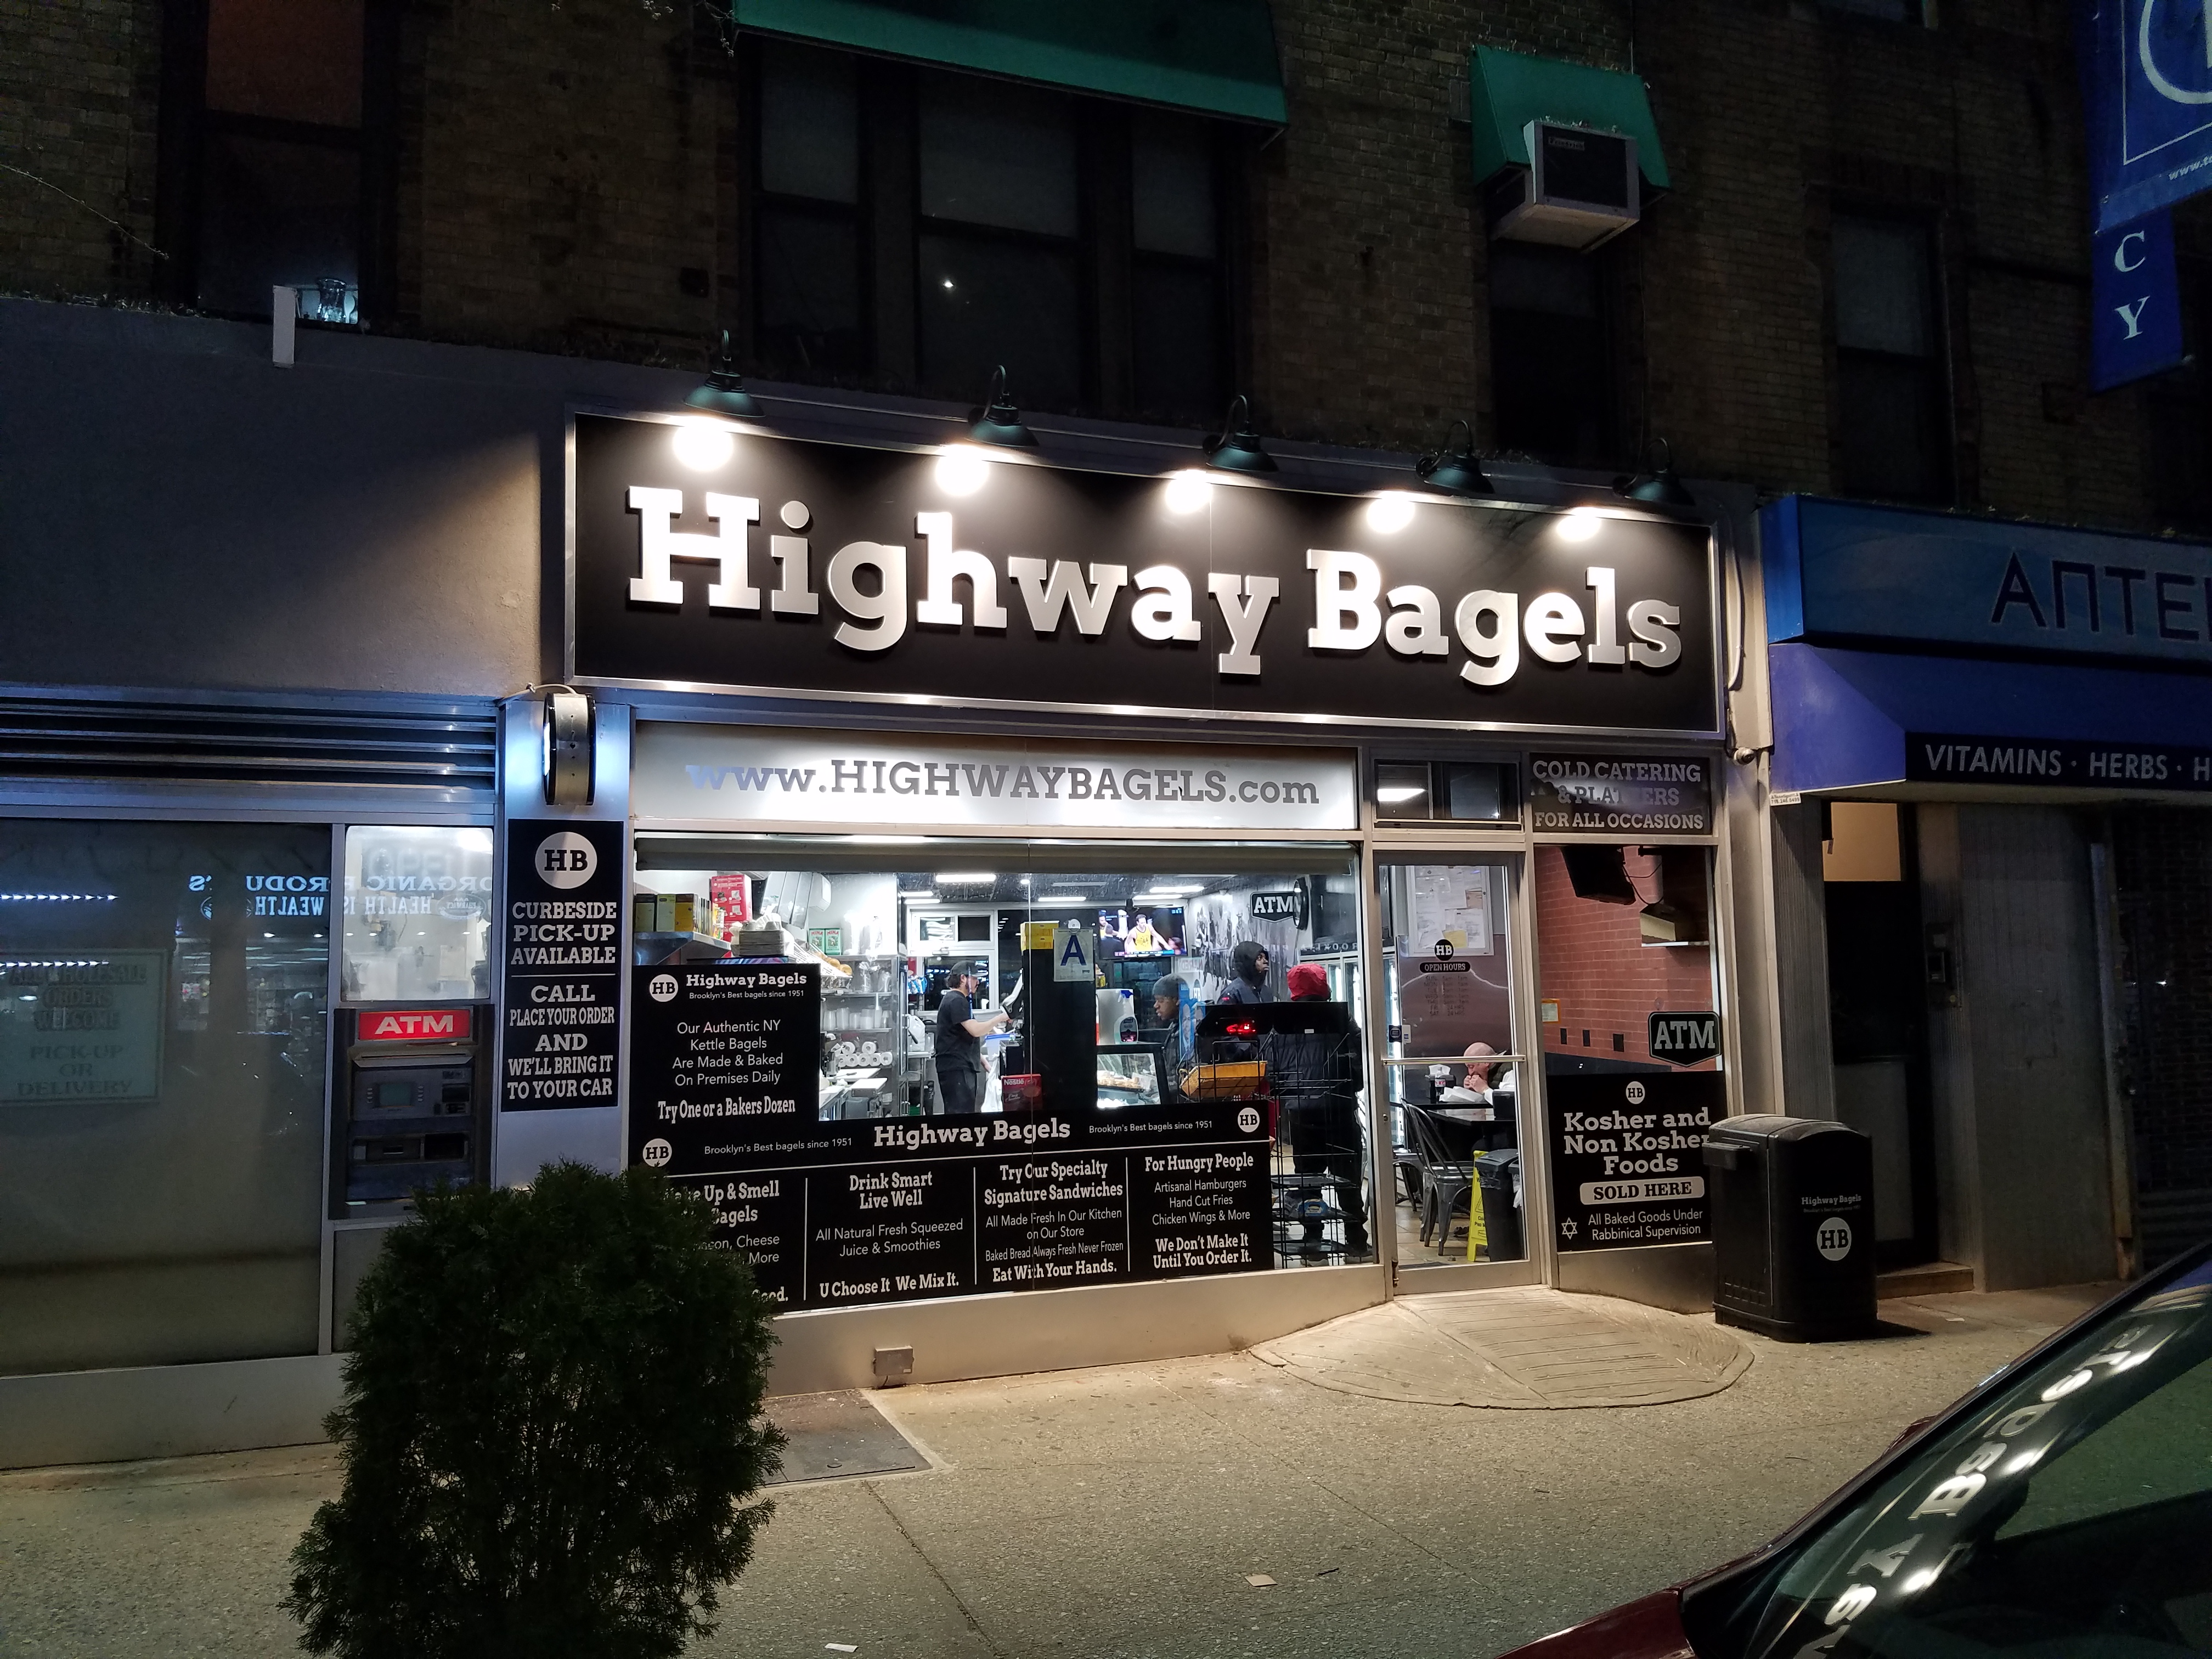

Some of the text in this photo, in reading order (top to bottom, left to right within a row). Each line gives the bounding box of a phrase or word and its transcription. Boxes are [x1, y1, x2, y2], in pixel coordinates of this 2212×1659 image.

[629, 484, 1679, 685] Highway Bagels
[1991, 551, 2212, 642] АПТЕ
[1926, 743, 2168, 780] VITAMINS HERBS
[1533, 760, 1701, 782] COLD CATERING
[1558, 785, 1679, 806] & PLAERS
[1535, 812, 1703, 830] FOR ALL OCCASIONS
[544, 849, 588, 872] HB
[512, 902, 617, 919] CURBESIDE
[1254, 896, 1293, 913] ATM
[514, 924, 615, 941] PICK-UP
[511, 947, 616, 964] AVAILABLE
[1060, 934, 1087, 966] A
[1436, 945, 1452, 955] HB
[1443, 963, 1466, 971] HOURS
[652, 982, 675, 994] HB
[686, 973, 806, 989] Highway Bagels
[531, 985, 595, 1002] CALL
[690, 992, 725, 1000] Brooklyn's
[744, 991, 767, 999] bagels
[375, 1015, 453, 1034] ATM
[510, 1007, 614, 1026] PLACE YOUR ORDER
[677, 1019, 781, 1034] Our Authentic NY
[1654, 1020, 1716, 1049] ATM
[535, 1034, 588, 1052] AND
[691, 1036, 766, 1052] Kettle Bagels
[554, 1056, 597, 1074] BRING
[599, 1055, 613, 1072] IT
[672, 1052, 783, 1069] Are Made & Baked
[675, 1070, 781, 1086] On Premises Daily
[507, 1078, 612, 1099] TO YOUR CAR
[1628, 1087, 1643, 1098] HB
[658, 1096, 795, 1124] Try One or a Bakers Dozen
[1564, 1107, 1711, 1131] Kosher and
[1239, 1114, 1257, 1126] HB
[874, 1118, 1070, 1150] Highway Bagels
[1564, 1130, 1709, 1154] Non Kosher
[704, 1138, 851, 1155] Brooklyn's Best bagels since 1951
[1000, 1159, 1108, 1184] Try Our Specialty
[1145, 1152, 1254, 1173] For Hungry People
[1604, 1153, 1678, 1175] Foods
[850, 1171, 932, 1190] Drink Smart
[1154, 1178, 1246, 1193] Artisanal Hamburgers
[704, 1185, 724, 1205] Up
[727, 1183, 736, 1200] &
[738, 1180, 780, 1199] Smell
[860, 1189, 922, 1209] Live Well
[985, 1181, 1122, 1208] Signature Sandwiches
[1593, 1181, 1692, 1200] SOLD HERE
[1170, 1194, 1233, 1208] Hand Cut Fries
[1801, 1194, 1861, 1206] Highway Bagels
[986, 1207, 1121, 1228] All Made Fresh In Our Kitchen
[1152, 1209, 1250, 1226] Chicken Wings & More
[1588, 1208, 1703, 1225] All Baked Goods Under
[816, 1218, 963, 1241] All Natural Fresh Squeezed
[1041, 1227, 1058, 1238] Our
[1060, 1226, 1084, 1237] Store
[1592, 1223, 1701, 1240] Rabbinical Supervision
[693, 1234, 780, 1251] acon, Cheese
[839, 1238, 940, 1256] Juice & Smoothies
[1820, 1229, 1849, 1250] HB
[748, 1251, 780, 1265] More
[986, 1241, 1123, 1261] Baked Bread Always Fresh Never Frozen
